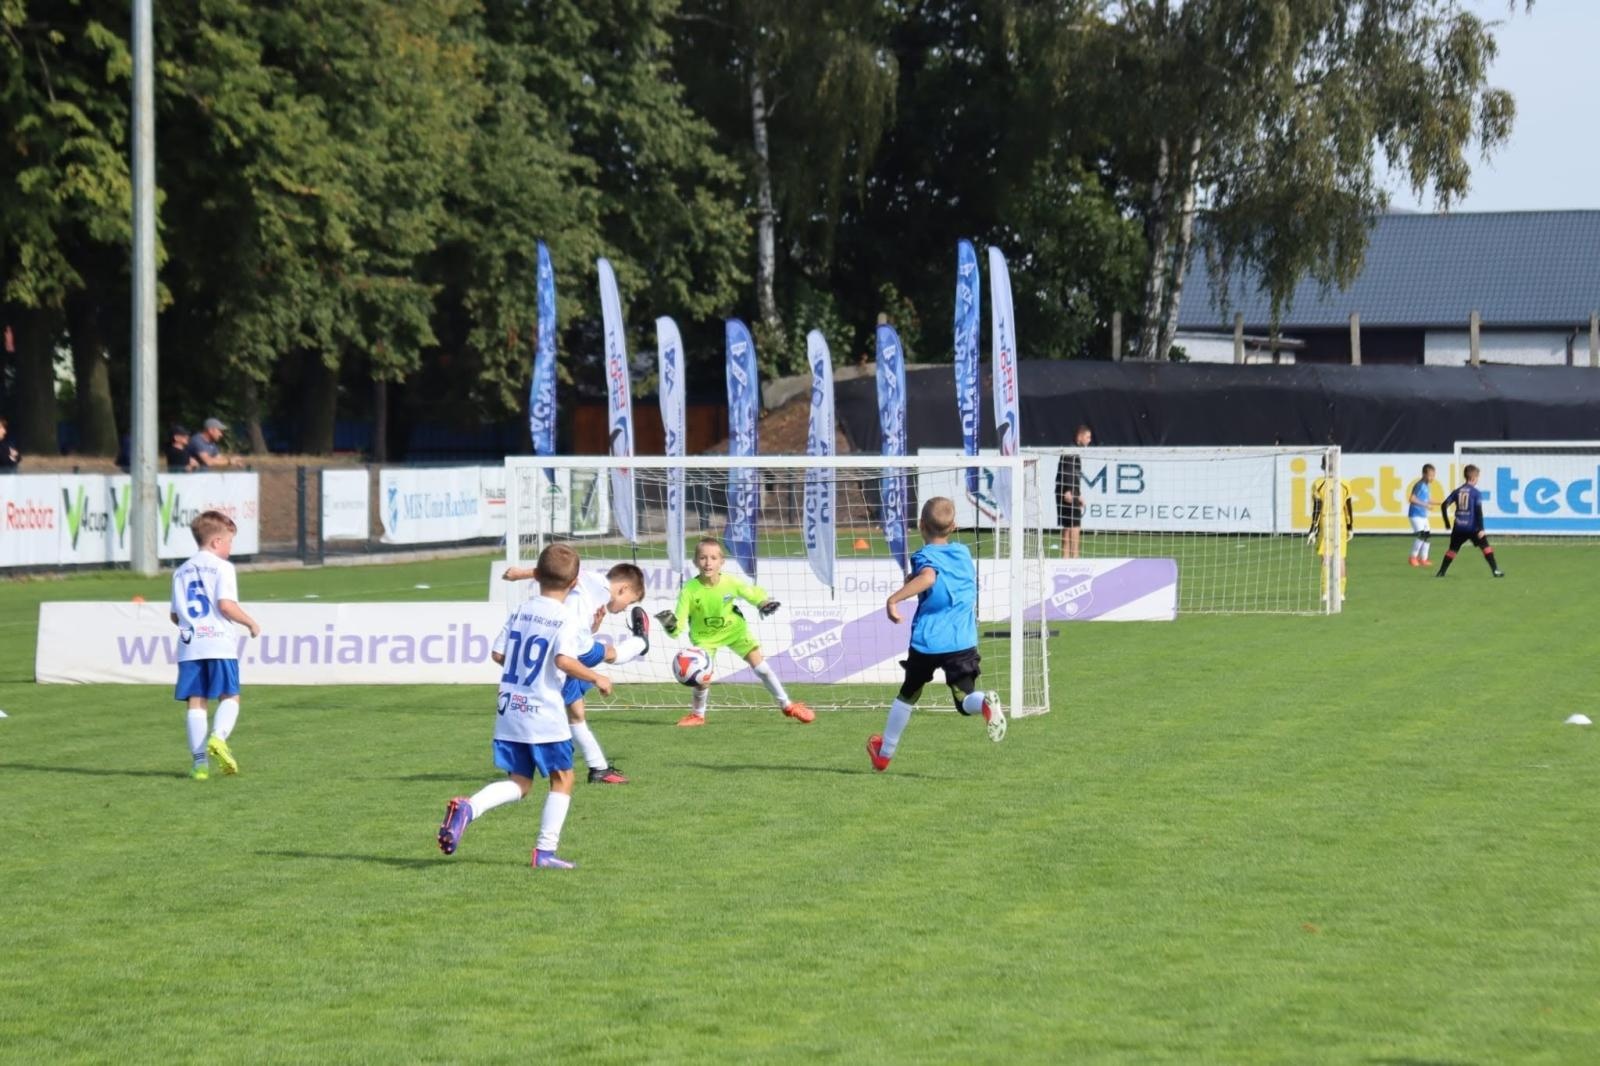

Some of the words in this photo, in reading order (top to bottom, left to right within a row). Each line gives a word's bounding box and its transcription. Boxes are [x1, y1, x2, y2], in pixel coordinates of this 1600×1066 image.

[1458, 491, 1469, 511] 10
[1081, 503, 1252, 521] BEZPIECZENIA
[187, 580, 210, 618] 5
[501, 630, 549, 687] 19
[509, 702, 540, 714] SPORT
[511, 694, 528, 703] PRO
